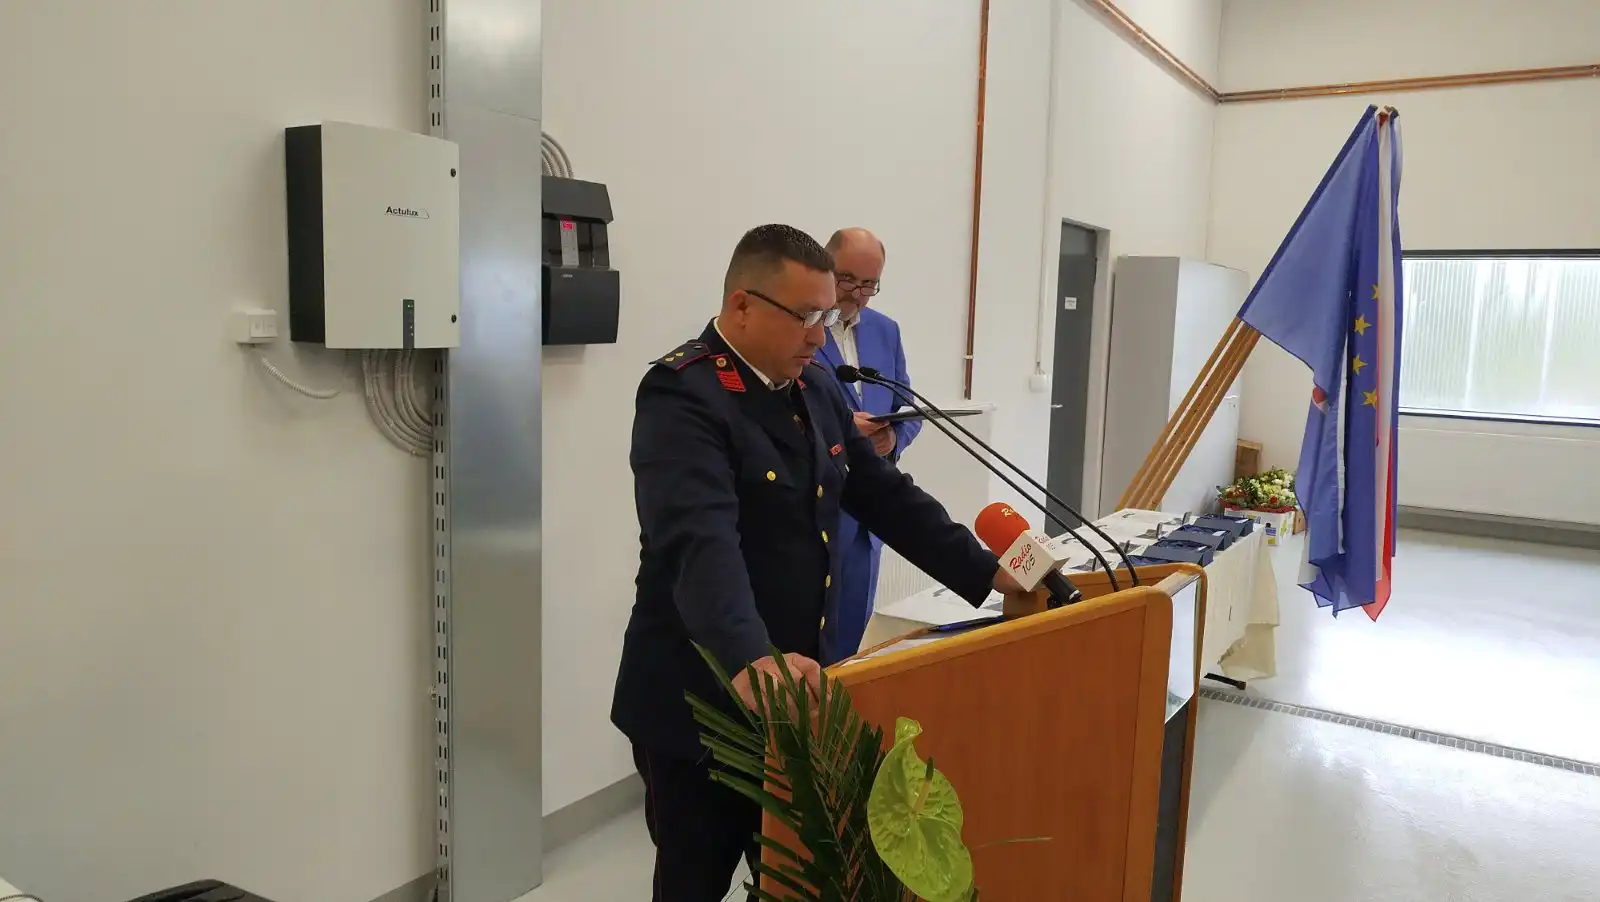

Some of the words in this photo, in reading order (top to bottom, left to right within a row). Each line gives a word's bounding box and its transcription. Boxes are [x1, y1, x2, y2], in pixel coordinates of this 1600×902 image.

[386, 206, 419, 217] Actulux
[1009, 543, 1032, 573] Radio
[1022, 554, 1036, 575] 105
